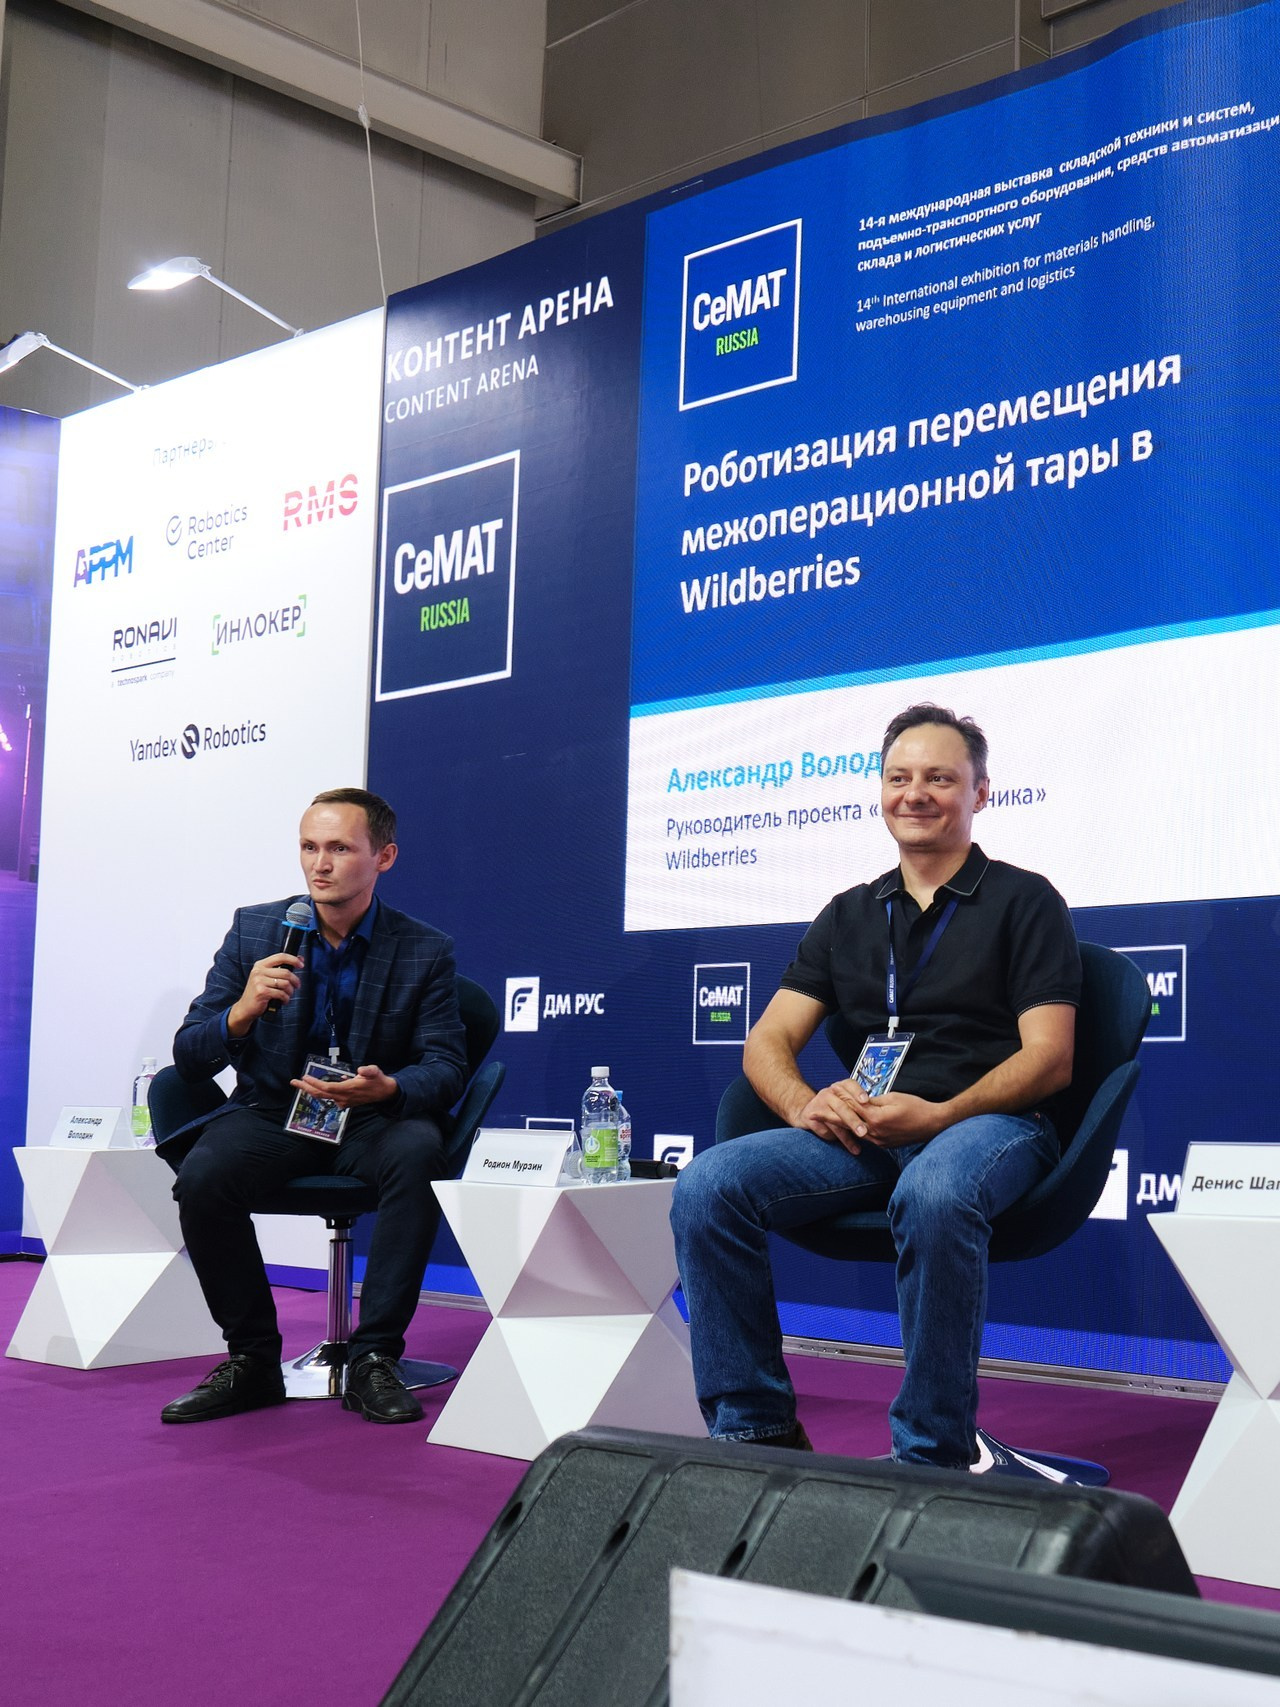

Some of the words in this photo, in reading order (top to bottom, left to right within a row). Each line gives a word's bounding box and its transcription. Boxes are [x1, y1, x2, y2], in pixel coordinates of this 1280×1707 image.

[858, 214, 886, 231] 14-я
[888, 185, 991, 226] международная
[994, 166, 1053, 194] выставка
[1059, 136, 1121, 174] складской
[1123, 118, 1179, 147] техники
[1182, 114, 1193, 127] и
[1197, 101, 1255, 125] систем,
[858, 199, 1018, 251] подъемно-транспортного
[1021, 165, 1114, 206] оборудования,
[1117, 145, 1168, 172] средств
[857, 251, 901, 273] склада
[904, 249, 912, 262] и
[914, 223, 1004, 258] логистических
[1008, 212, 1042, 235] услуг
[883, 276, 958, 307] International
[961, 260, 1020, 287] exhibition
[1023, 255, 1042, 271] for
[1044, 235, 1099, 264] materials
[1101, 215, 1155, 245] handling,
[693, 267, 788, 332] CeMAT
[855, 304, 930, 332] warehousing
[933, 287, 997, 316] equipment
[1000, 278, 1024, 297] and
[1027, 265, 1075, 290] logistics
[386, 311, 511, 384] КОНТЕНТ
[518, 276, 614, 340] АРЕНА
[716, 327, 759, 356] RUSSIA
[385, 377, 471, 424] CONTENT
[476, 354, 539, 396] ARENA
[683, 425, 897, 498] Роботизация
[908, 353, 1182, 448] перемещения
[283, 473, 358, 532] RMS
[681, 453, 1016, 557] межоперационной
[1026, 435, 1119, 493] тары
[1132, 428, 1154, 460] в
[188, 503, 248, 536] Robotics
[187, 535, 234, 561] Center
[393, 518, 504, 595] CeMAT
[680, 553, 861, 614] Wildberries
[112, 617, 177, 652] RONAVI
[420, 597, 470, 632] RUSSIA
[130, 735, 177, 762] Yandex
[203, 720, 266, 751] Robotics
[667, 759, 793, 793] Александр
[801, 751, 882, 779] Волод
[667, 810, 782, 840] Руководитель
[788, 804, 862, 830] проекта
[666, 846, 758, 871] Wildberries
[543, 993, 571, 1019] ДМ
[575, 992, 605, 1015] РУС
[699, 985, 744, 1007] CeMAT
[70, 1115, 103, 1126] Александр
[482, 1158, 511, 1170] Родион
[512, 1159, 543, 1172] Мурзин
[1191, 1175, 1244, 1192] Денис
[1136, 1172, 1182, 1206] ДМ
